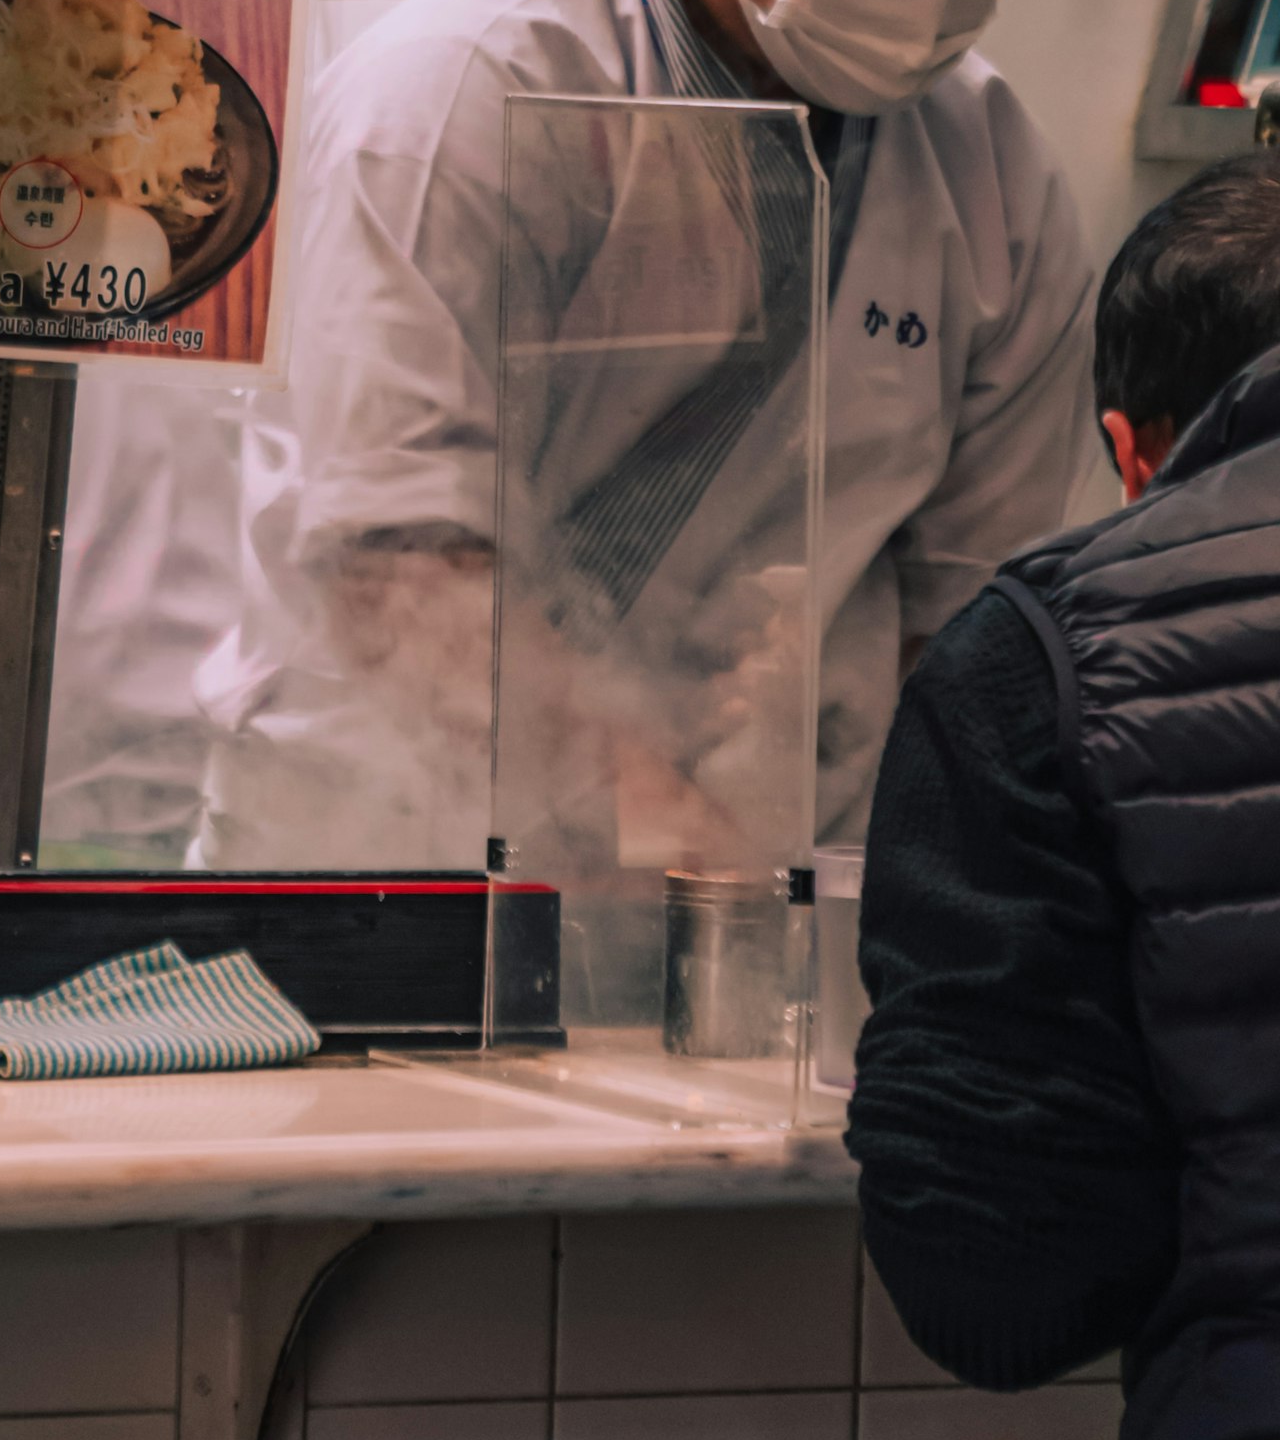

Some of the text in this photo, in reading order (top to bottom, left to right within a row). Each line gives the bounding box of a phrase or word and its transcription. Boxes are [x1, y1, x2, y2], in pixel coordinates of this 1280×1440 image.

[44, 260, 147, 313] ¥430
[35, 317, 68, 338] and
[72, 317, 168, 344] Harf-boiled
[172, 329, 204, 350] egg
[864, 300, 927, 349] かめ
